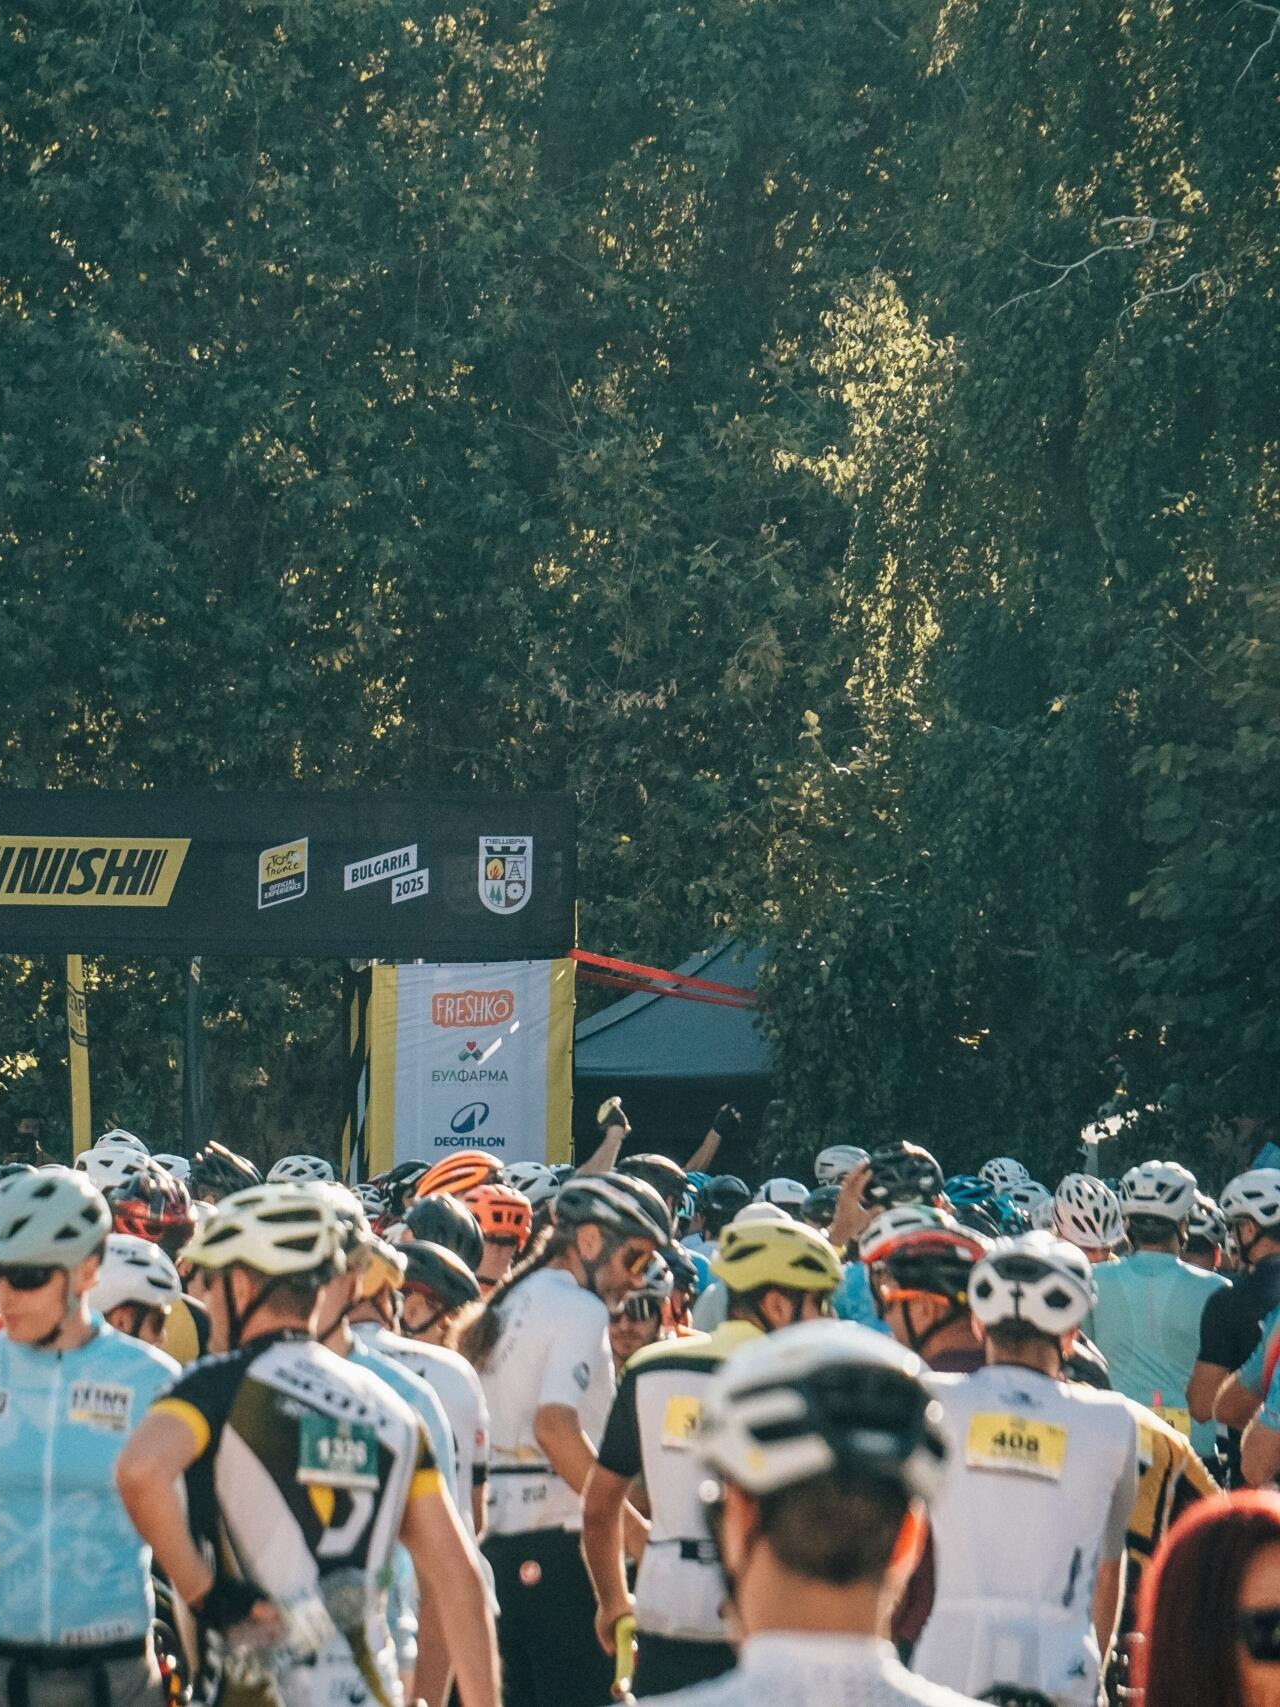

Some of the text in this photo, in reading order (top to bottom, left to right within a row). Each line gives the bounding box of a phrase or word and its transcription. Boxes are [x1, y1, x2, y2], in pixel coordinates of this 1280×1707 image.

[351, 852, 411, 883] BULGARIA
[395, 875, 424, 898] 2025
[432, 1068, 509, 1083] БУЛФАРМА
[434, 1136, 506, 1148] DECATHLON
